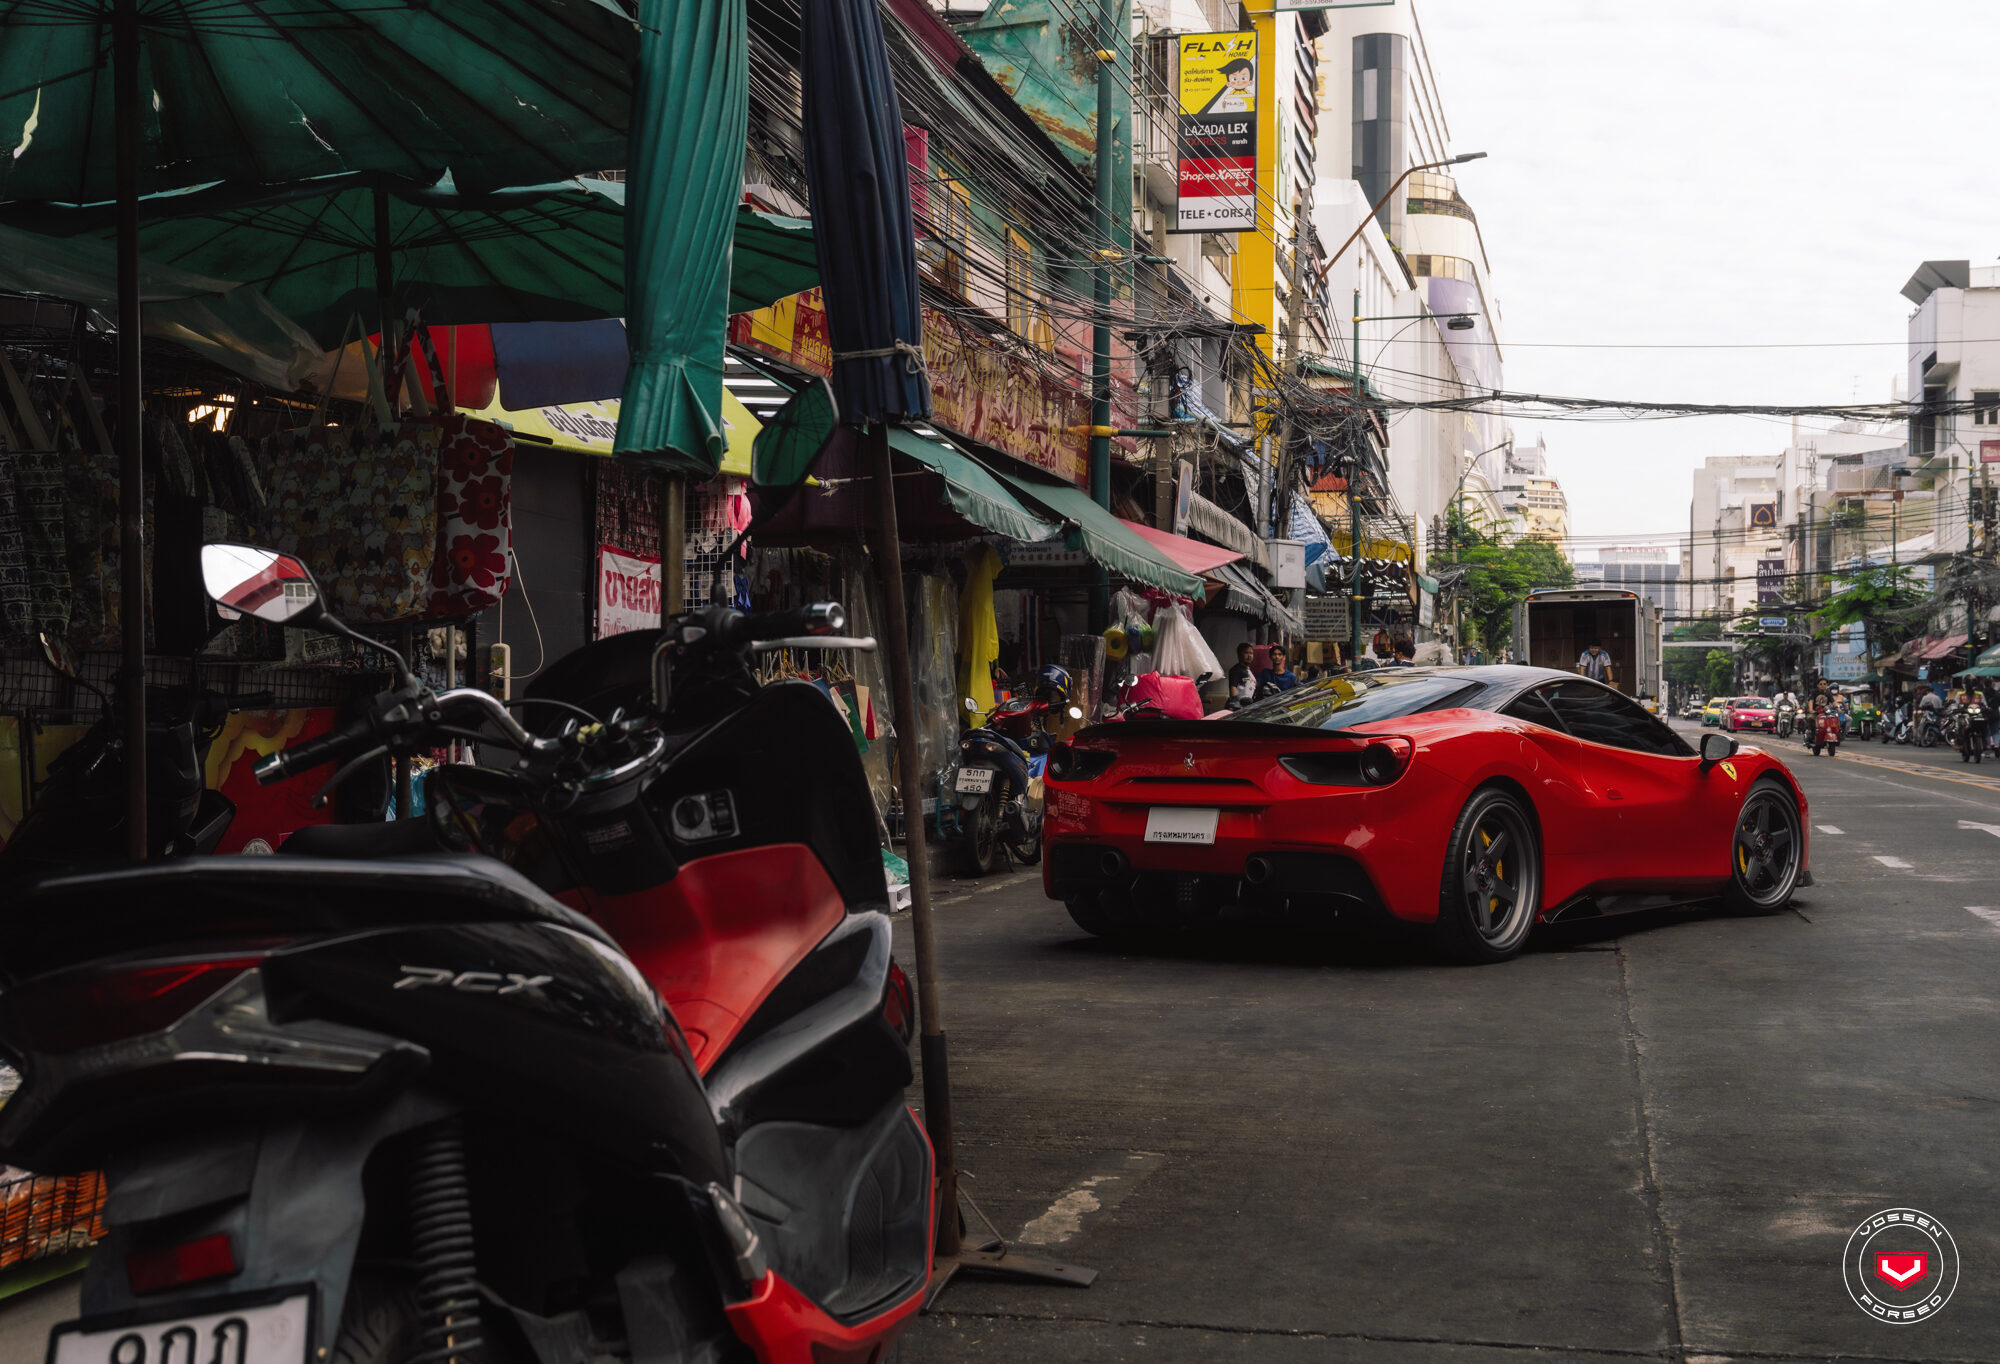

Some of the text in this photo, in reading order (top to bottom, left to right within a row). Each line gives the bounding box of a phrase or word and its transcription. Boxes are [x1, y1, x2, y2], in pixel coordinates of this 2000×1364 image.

[1184, 38, 1253, 54] FLASH
[1185, 122, 1248, 136] LAZADA LEX
[1185, 136, 1227, 146] EXPRESS
[1179, 208, 1252, 219] TELE CORSA
[392, 965, 554, 996] PCX
